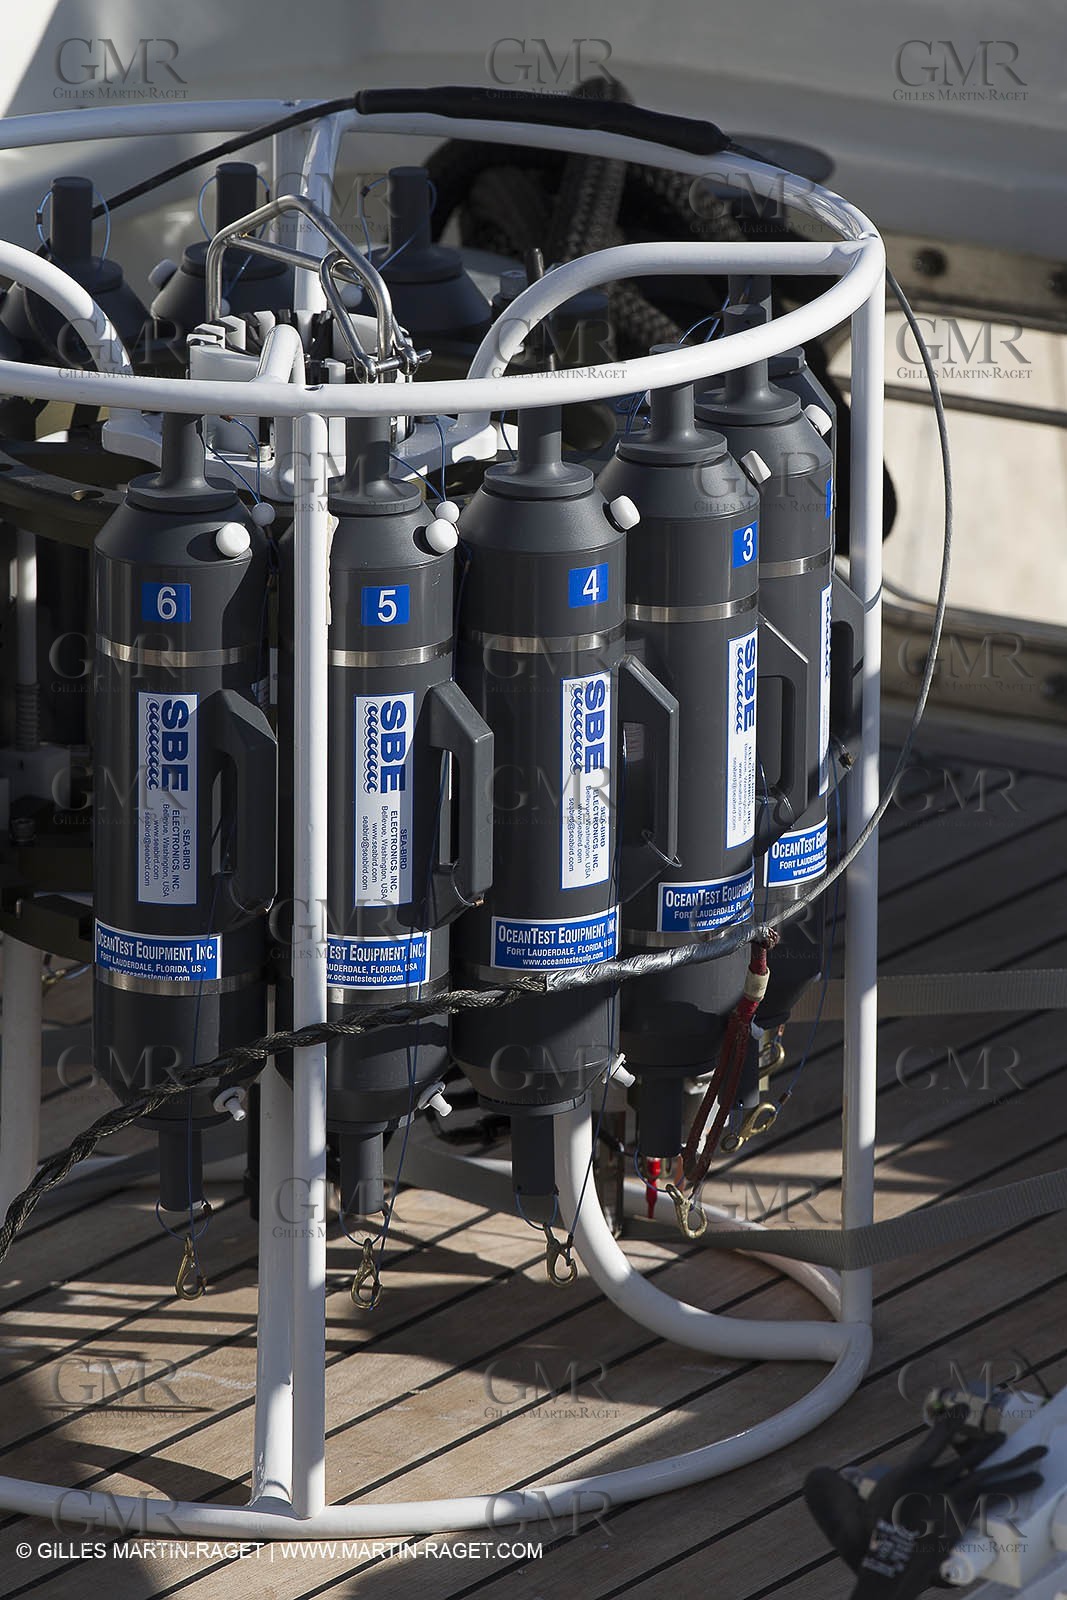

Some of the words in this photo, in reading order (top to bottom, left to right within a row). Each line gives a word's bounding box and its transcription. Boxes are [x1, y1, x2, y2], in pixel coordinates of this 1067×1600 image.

[743, 527, 754, 562] 3
[582, 568, 600, 601] 4
[157, 586, 176, 620] 6
[377, 589, 397, 623] 5
[743, 637, 756, 733] SBE
[584, 679, 606, 774] SBE
[161, 698, 190, 792] SBE
[380, 700, 407, 794] SBE
[171, 809, 181, 873] ELECTRONICS,
[182, 828, 191, 871] SEA-BIRD
[360, 815, 370, 891] seabird@seabird.com
[371, 822, 379, 883] www.seabird.com
[389, 810, 398, 874] ELECTRONICS,
[400, 828, 408, 870] SEA-BIRD
[779, 859, 797, 870] FORT
[162, 880, 170, 897] USA
[171, 874, 181, 892] INC.
[380, 882, 388, 900] USA
[390, 875, 398, 893] INC.
[674, 910, 694, 919] FORT
[558, 921, 606, 944] EQUIPMENT,
[112, 956, 155, 973] LAUDERDALE,
[156, 963, 190, 974] FLORIDA,
[136, 941, 194, 963] EQUIPMENT,
[196, 943, 216, 961] INC.
[349, 944, 407, 962] EQUIPMENT,
[506, 946, 525, 956] FORT
[527, 947, 576, 957] LAUDERDALE,
[522, 951, 604, 966] www.oceantestequip.com
[370, 964, 404, 974] FLORIDA,
